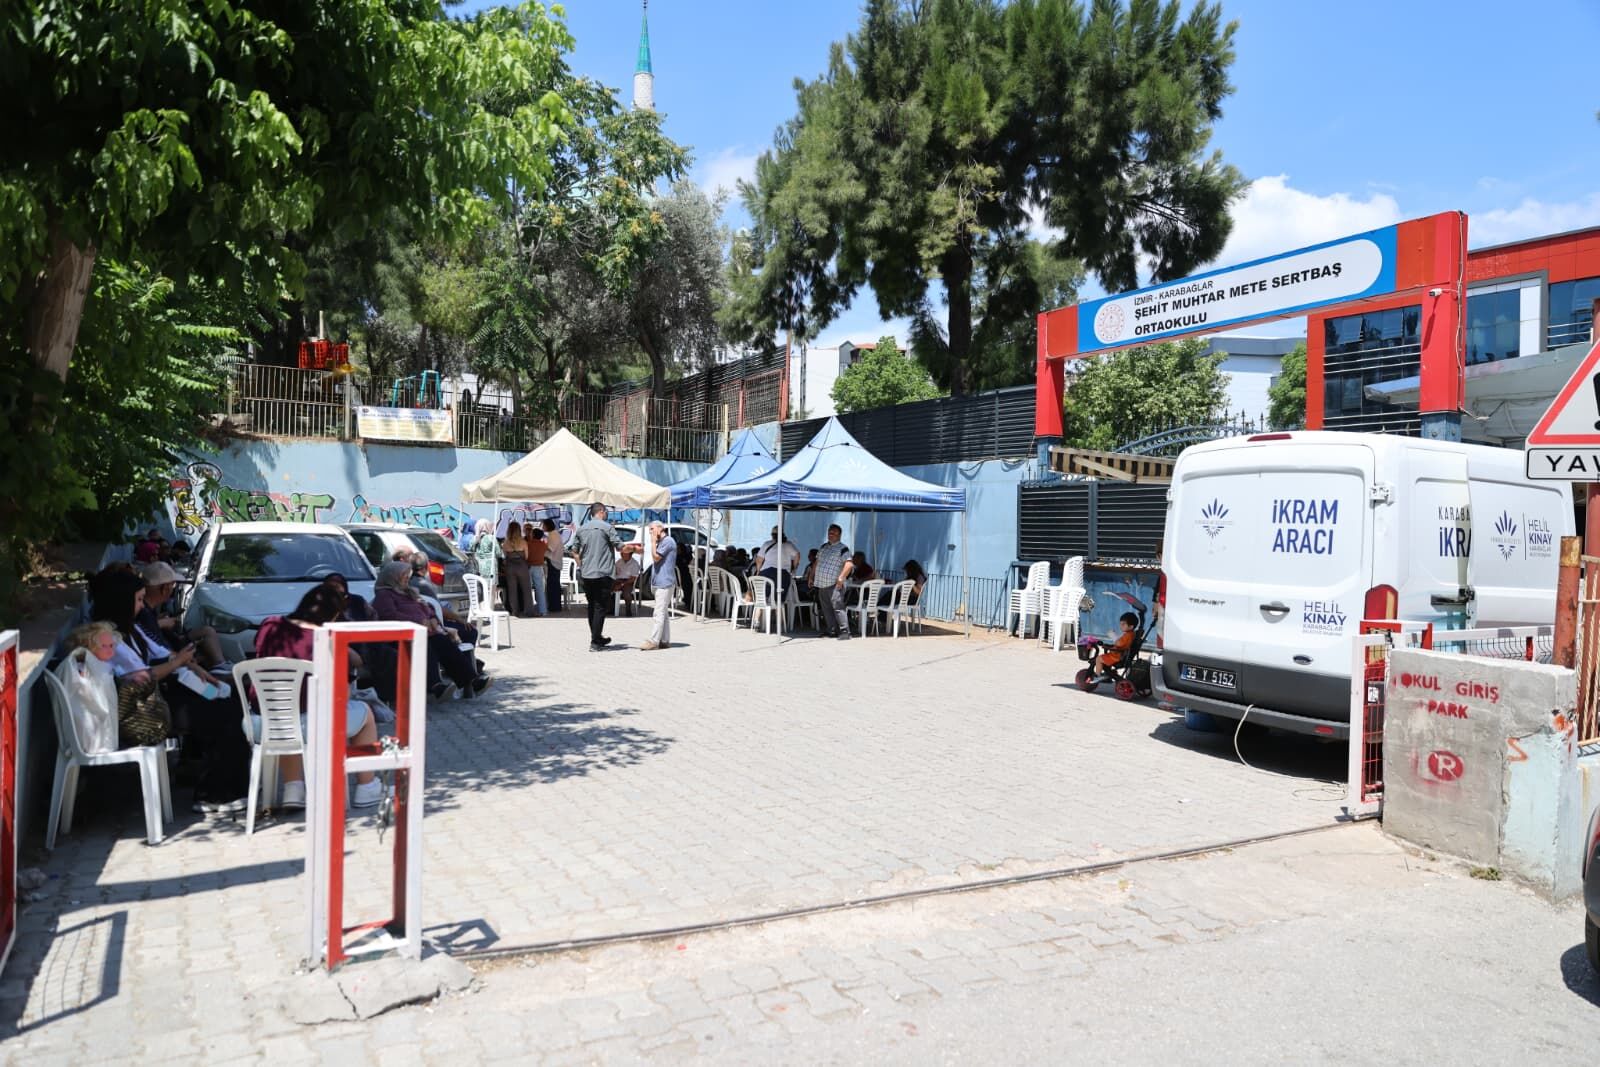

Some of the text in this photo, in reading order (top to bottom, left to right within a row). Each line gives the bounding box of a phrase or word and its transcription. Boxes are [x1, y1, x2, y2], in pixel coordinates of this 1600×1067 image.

[1134, 262, 1342, 321] ŞEHİT MUHTAR METE SERTBAŞ
[1134, 294, 1153, 306] İZMİR
[1159, 280, 1214, 300] KARABAĞLAR
[1134, 312, 1207, 335] ORTAOKULU
[1272, 499, 1338, 524] İKRAM
[1272, 528, 1334, 555] ARACI
[1529, 532, 1553, 545] KINAY
[1303, 600, 1344, 614] HELİL
[1303, 612, 1347, 626] KINAY
[1186, 667, 1197, 679] 35
[1212, 671, 1235, 686] 5152
[1401, 673, 1499, 704] OKUL GİRİŞ
[1428, 699, 1469, 719] PARK
